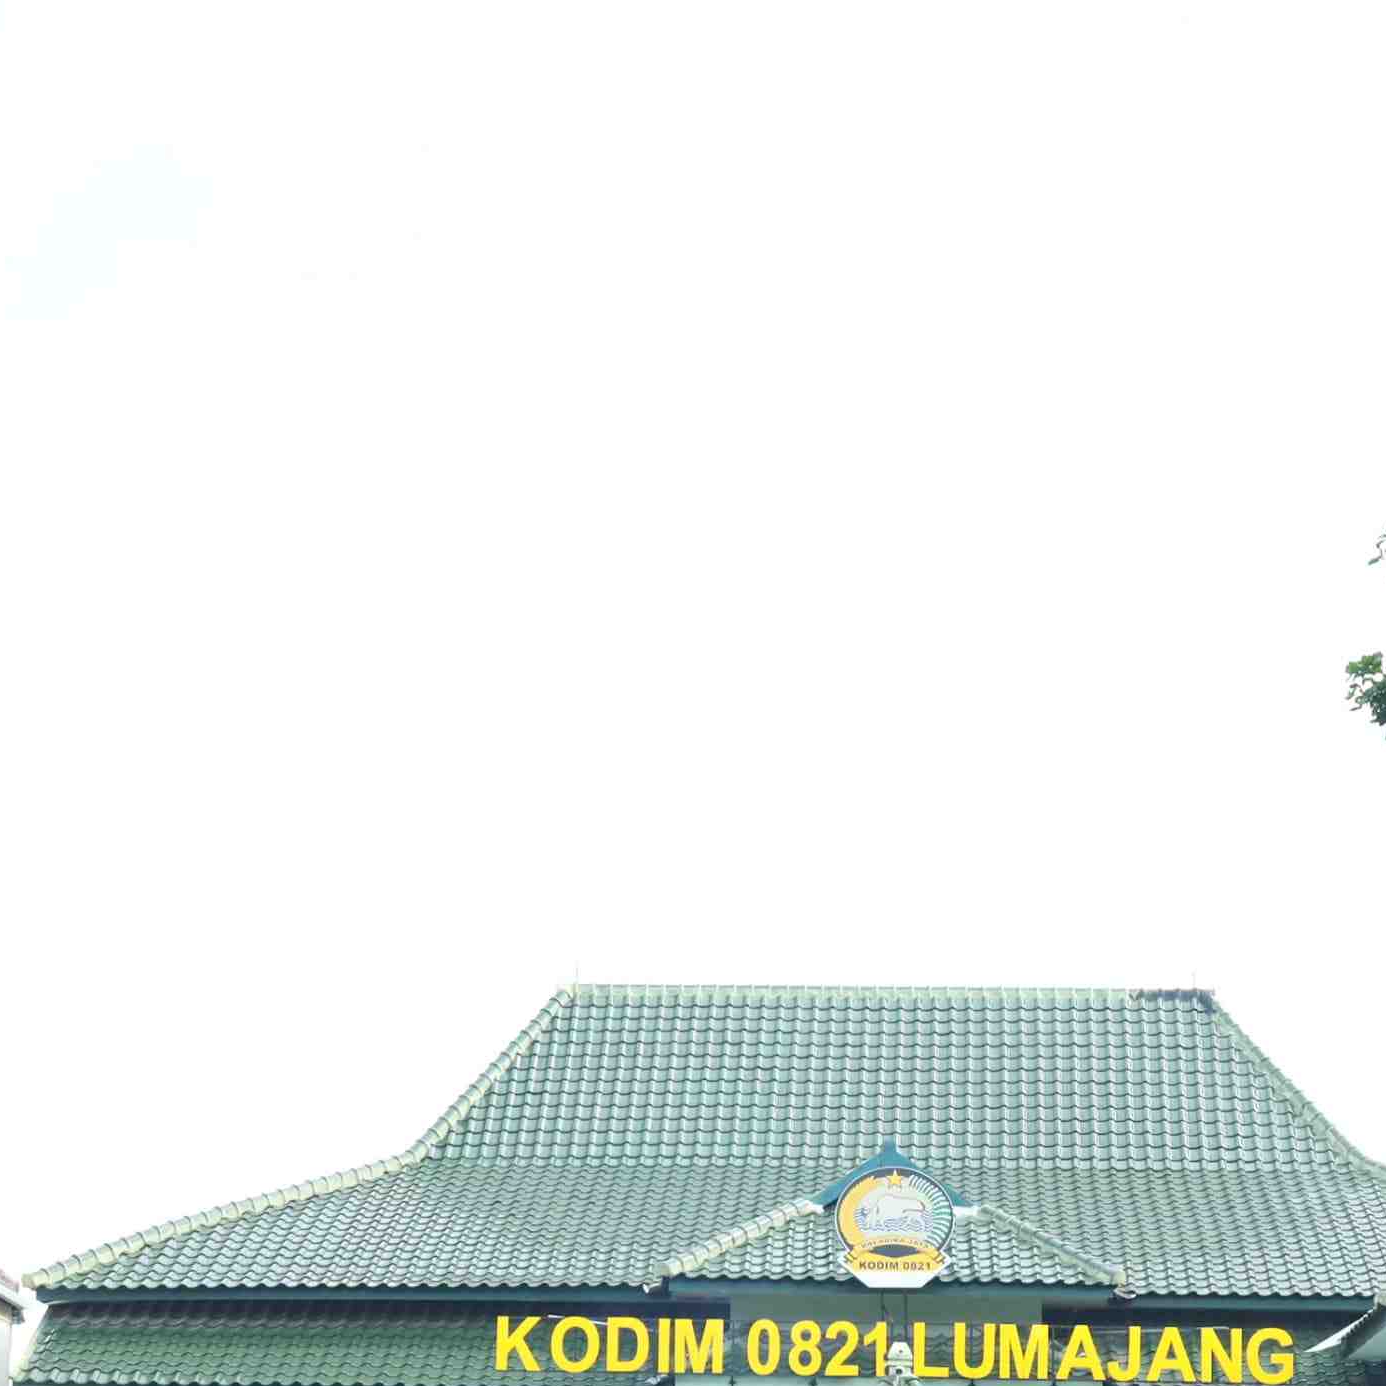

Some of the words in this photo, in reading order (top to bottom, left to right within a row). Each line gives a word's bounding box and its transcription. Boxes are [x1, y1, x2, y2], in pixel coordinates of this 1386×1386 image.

[859, 1261, 899, 1270] KODIM
[495, 1315, 724, 1373] KODIM
[747, 1319, 887, 1376] 0821
[913, 1322, 1293, 1384] LUMAJANG
